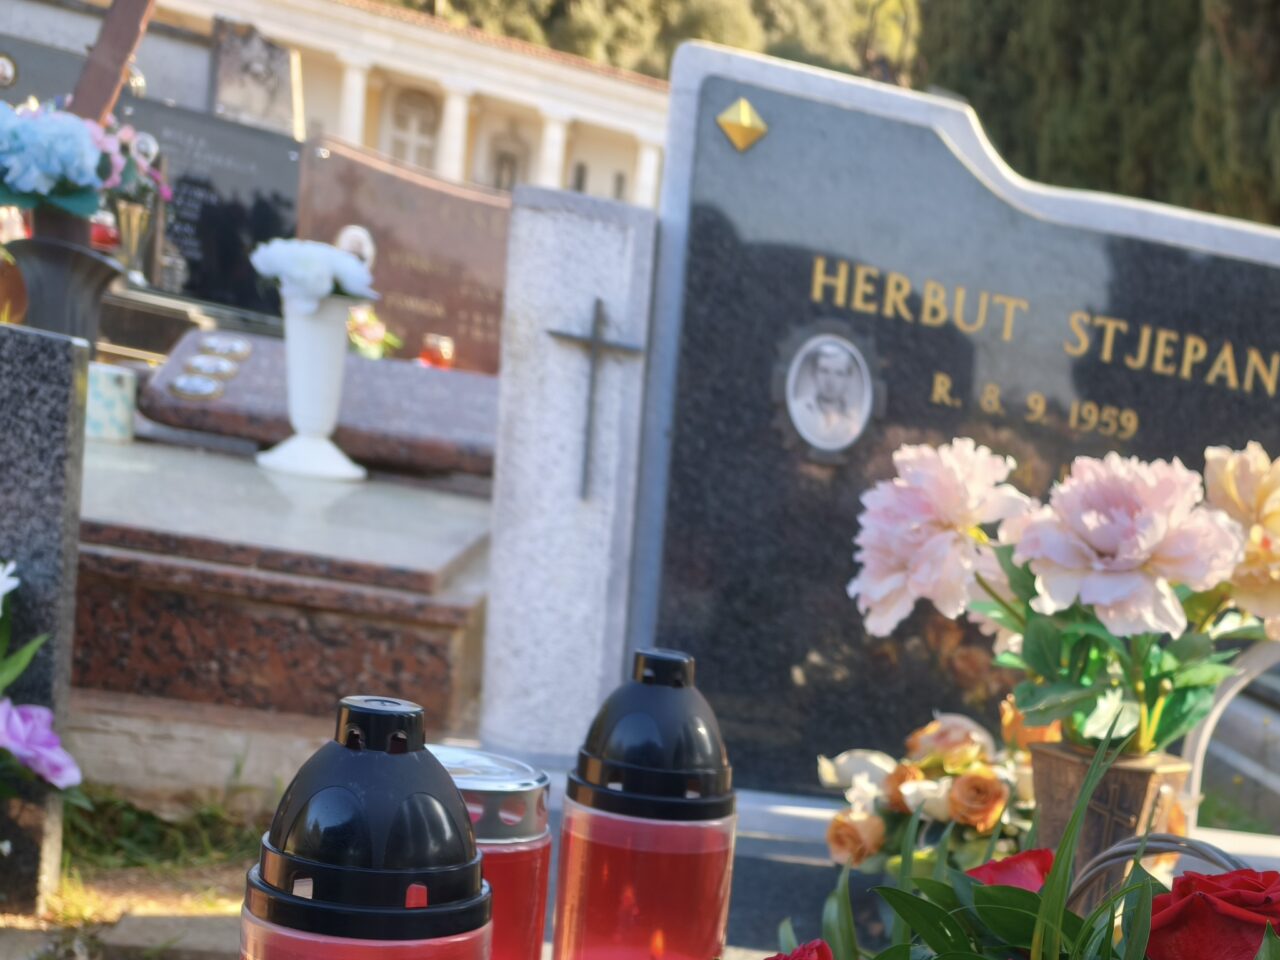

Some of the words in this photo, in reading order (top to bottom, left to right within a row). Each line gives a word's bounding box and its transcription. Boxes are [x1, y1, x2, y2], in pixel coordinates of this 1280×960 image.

[810, 256, 1028, 341] HERBUT
[931, 371, 962, 408] R.
[1069, 401, 1140, 441] 1959
